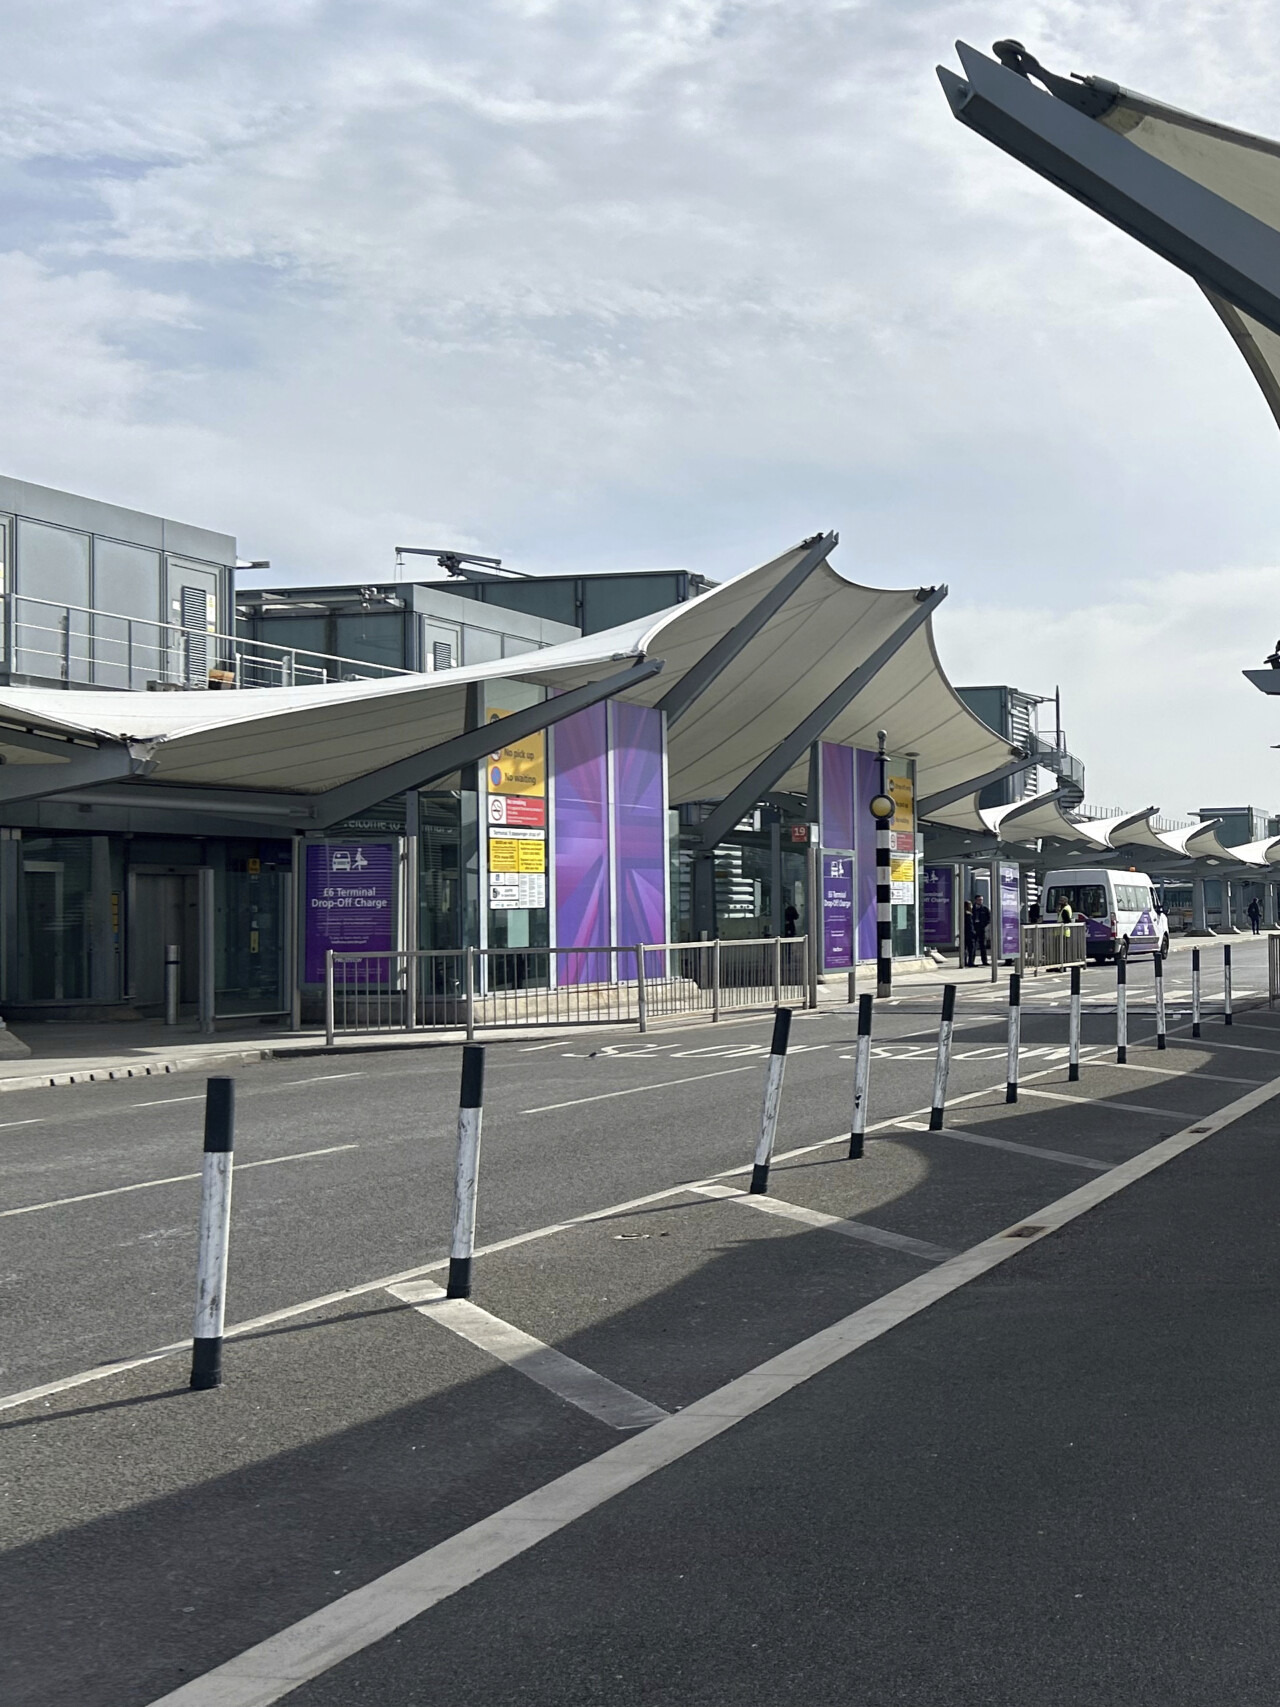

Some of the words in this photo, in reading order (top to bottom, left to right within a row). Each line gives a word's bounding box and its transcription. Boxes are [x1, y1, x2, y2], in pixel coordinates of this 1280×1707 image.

[504, 748, 513, 757] No
[513, 749, 525, 759] pick
[527, 752, 534, 761] up
[504, 772, 513, 781] No
[514, 774, 537, 786] waiting
[794, 827, 806, 836] 19
[323, 888, 335, 897] £6
[336, 887, 376, 897] Terminal
[311, 898, 353, 909] Drop-Off
[354, 898, 388, 909] Charge
[561, 1043, 831, 1058] SLOW
[838, 1046, 1098, 1060] SLOW
